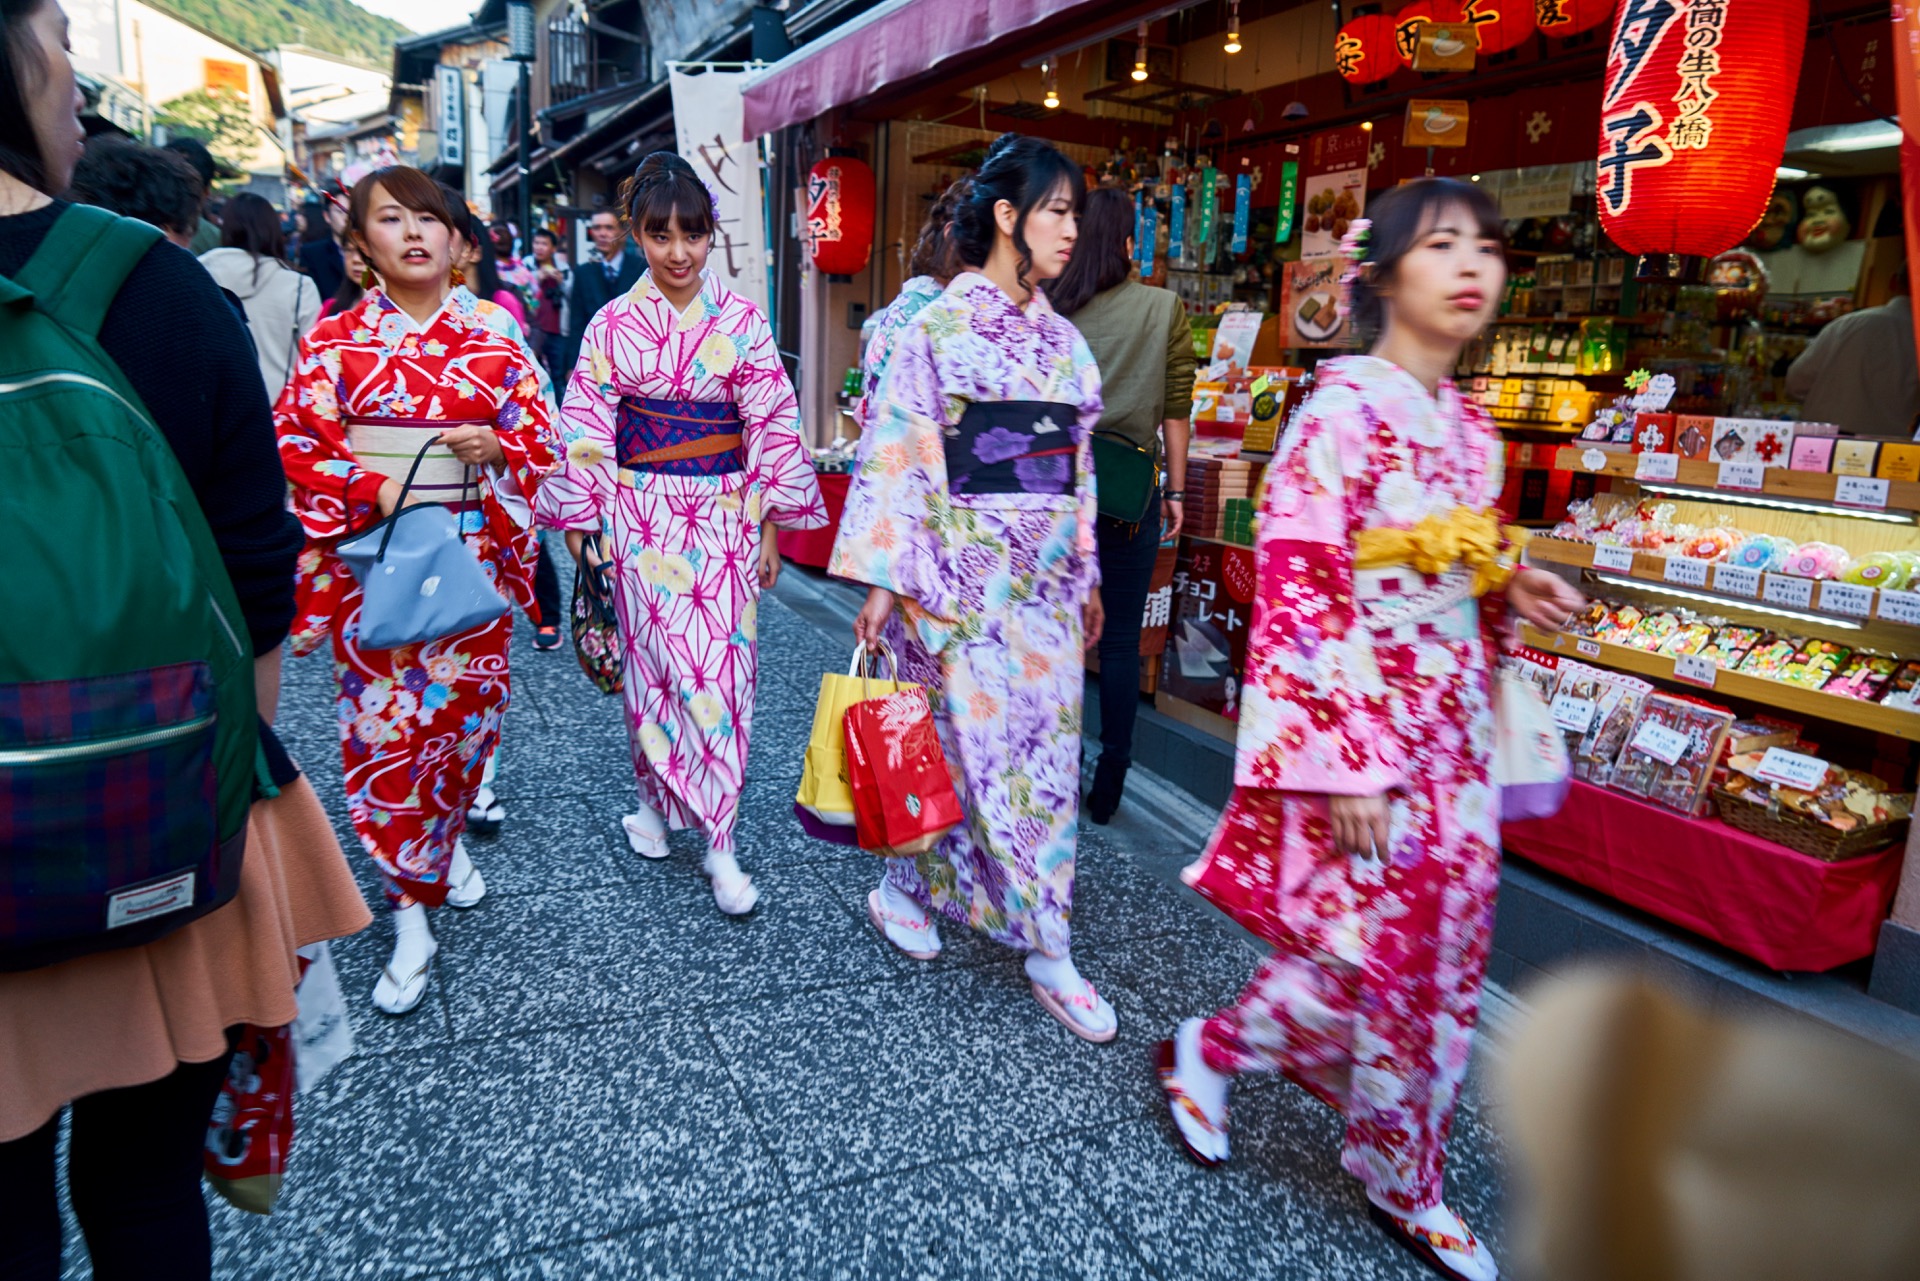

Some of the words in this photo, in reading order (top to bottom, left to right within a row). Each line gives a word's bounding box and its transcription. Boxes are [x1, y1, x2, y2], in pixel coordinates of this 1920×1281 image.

[1173, 571, 1217, 600] チョコ
[1198, 601, 1243, 631] レート
